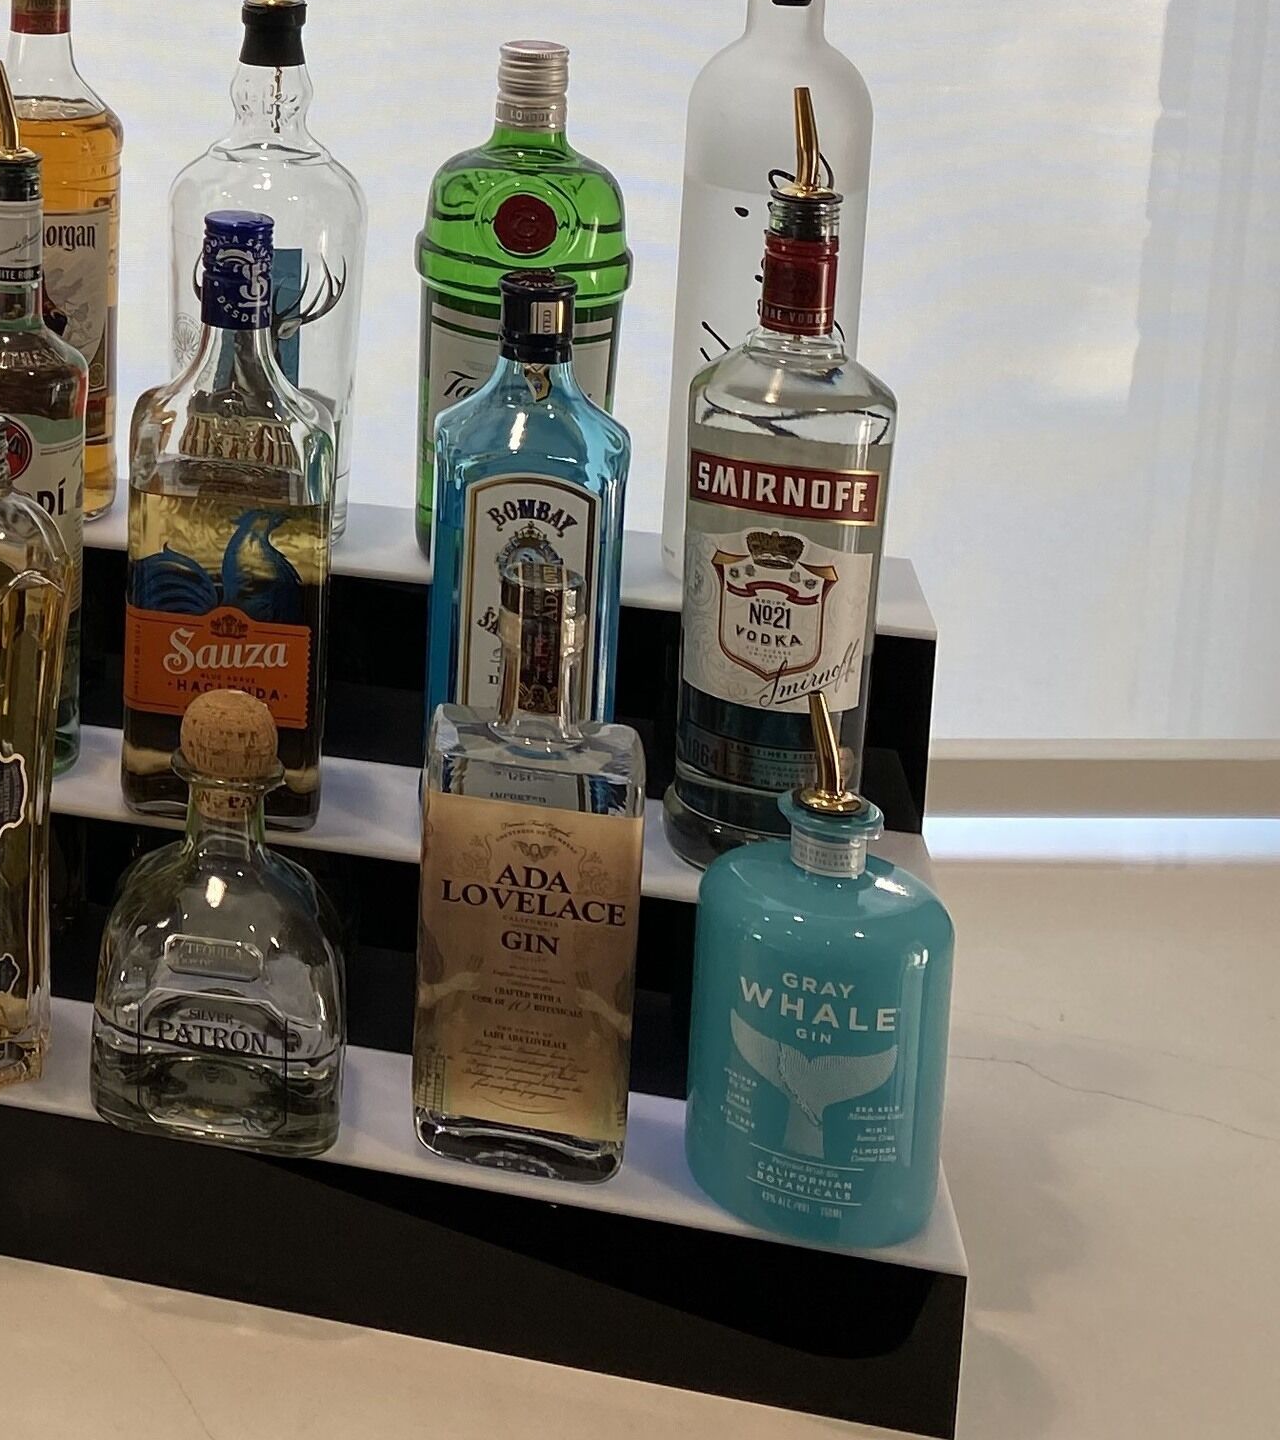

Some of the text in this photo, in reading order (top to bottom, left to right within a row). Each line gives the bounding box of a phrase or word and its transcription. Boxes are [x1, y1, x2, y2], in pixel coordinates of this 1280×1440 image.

[697, 460, 867, 515] SMIRNOFF
[486, 497, 578, 536] BOMBAY
[163, 627, 289, 675] Sauza
[735, 625, 804, 648] VODKA
[753, 638, 860, 707] Smirnoff
[495, 864, 572, 895] ADA
[440, 879, 627, 927] LOVELACE
[501, 930, 560, 955] GIN
[782, 973, 855, 999] GRAY
[191, 1009, 233, 1024] SILVER
[740, 976, 896, 1032] WHALE
[796, 1029, 832, 1044] GIN
[756, 1171, 851, 1200] BOTANICALS
[757, 1161, 852, 1190] CALIFORNIAN
